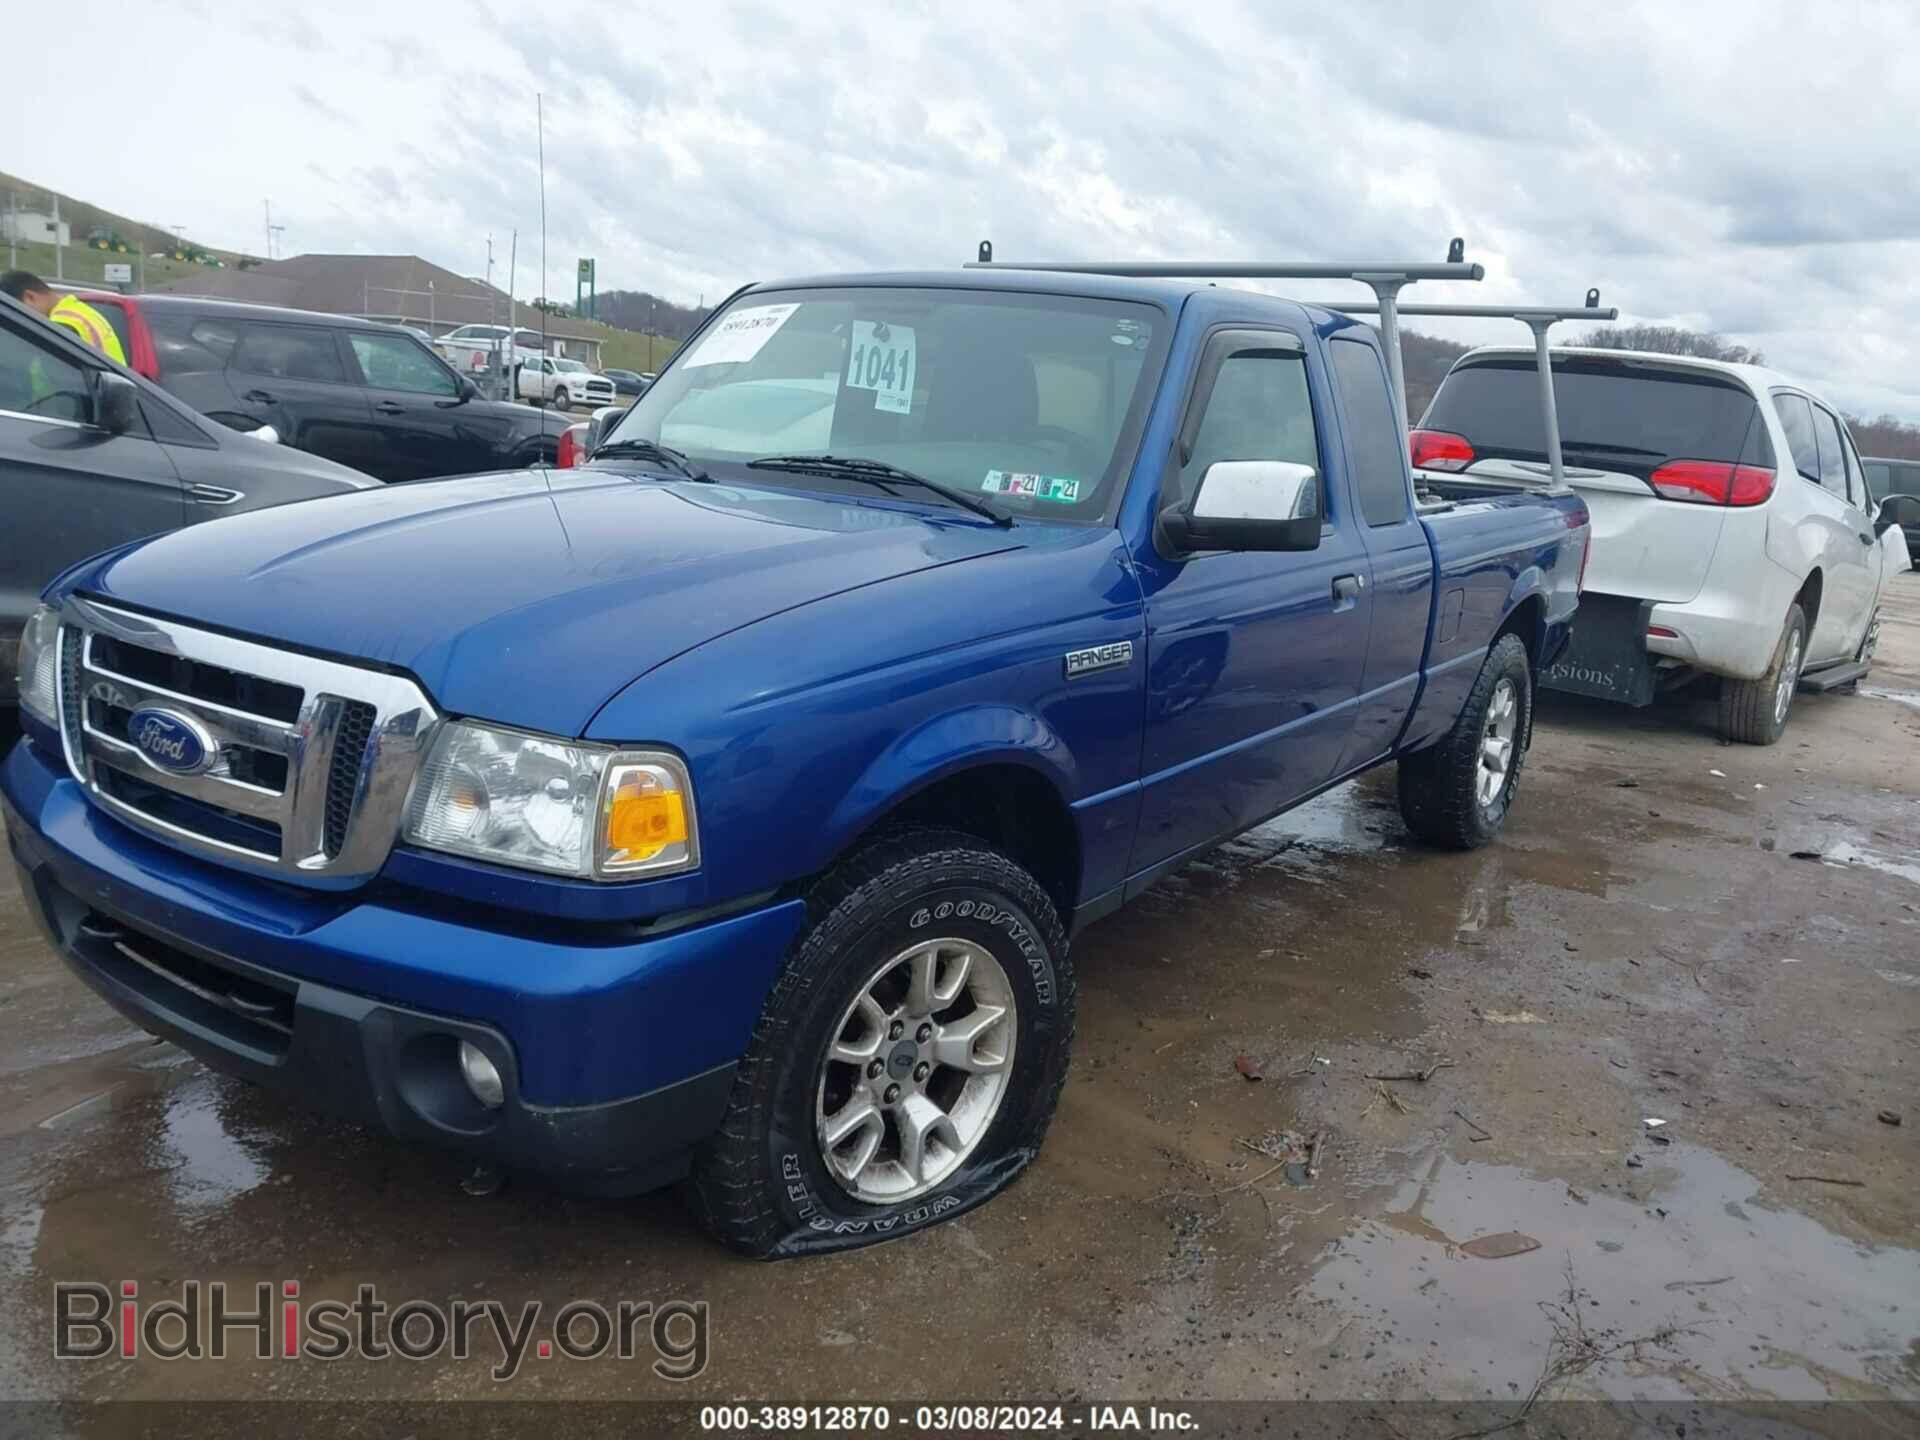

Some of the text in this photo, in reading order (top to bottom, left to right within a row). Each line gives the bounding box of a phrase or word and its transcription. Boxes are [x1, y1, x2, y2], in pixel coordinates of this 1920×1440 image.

[854, 343, 909, 391] 1041
[1069, 643, 1131, 669] RANGER
[140, 717, 186, 760] Ford
[910, 900, 1051, 1005] GOODYEAR
[782, 1154, 961, 1233] WRANGLER
